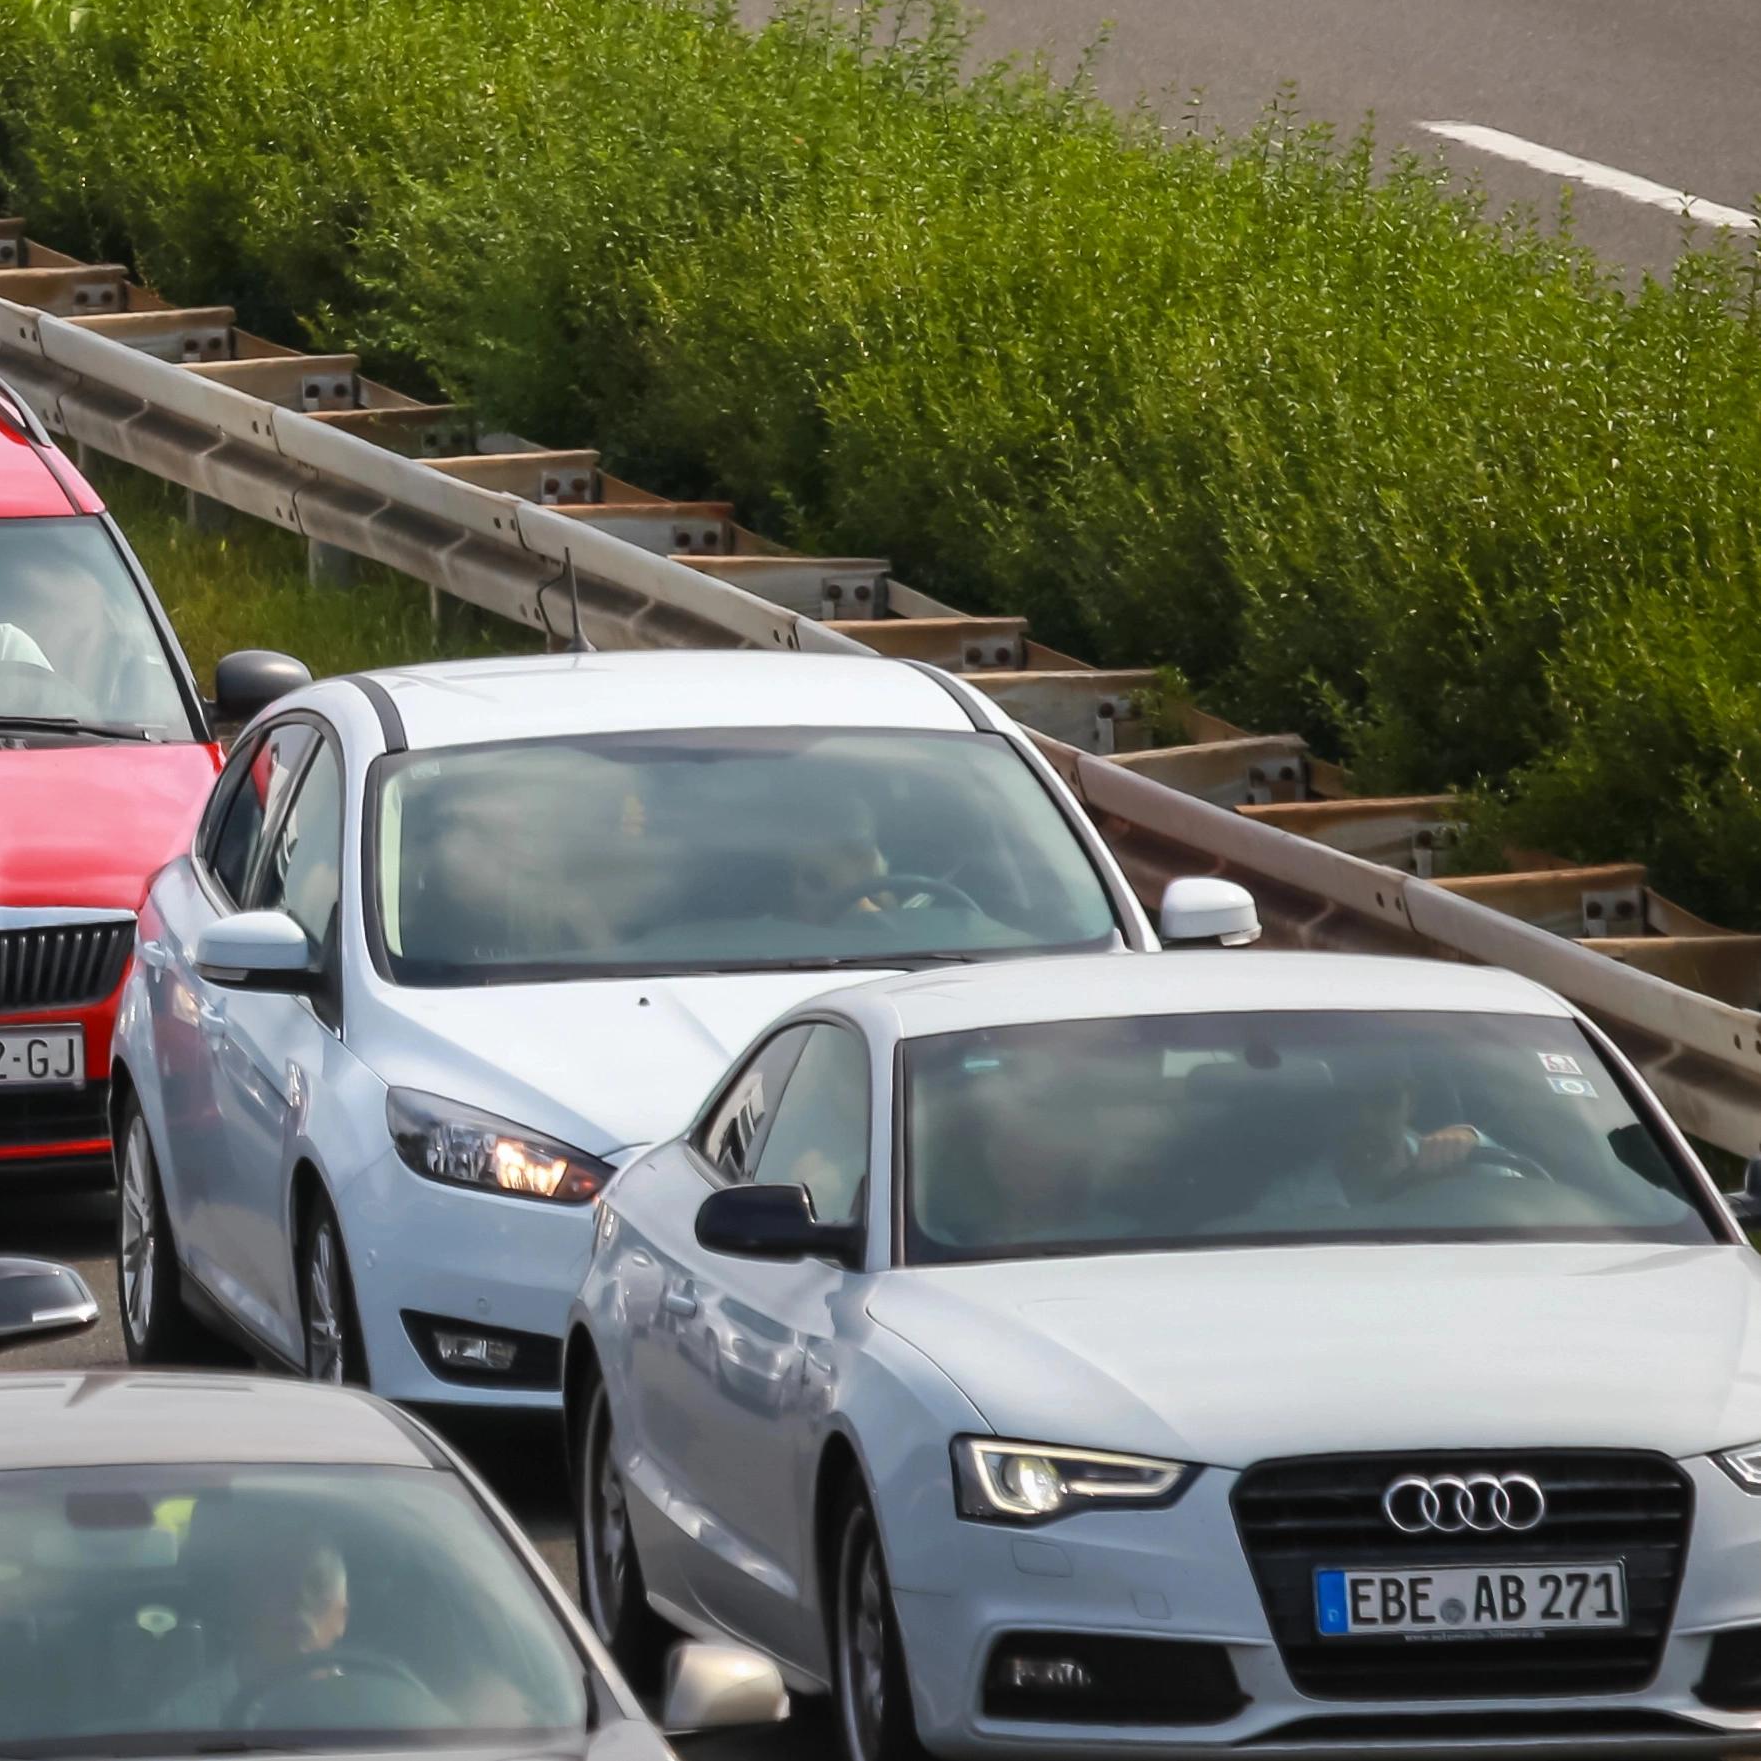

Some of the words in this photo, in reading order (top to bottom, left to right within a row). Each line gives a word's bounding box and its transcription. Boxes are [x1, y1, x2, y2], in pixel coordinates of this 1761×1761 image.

[1350, 1577, 1436, 1626] EBE
[1474, 1574, 1527, 1623] AB
[1539, 1573, 1619, 1620] 271
